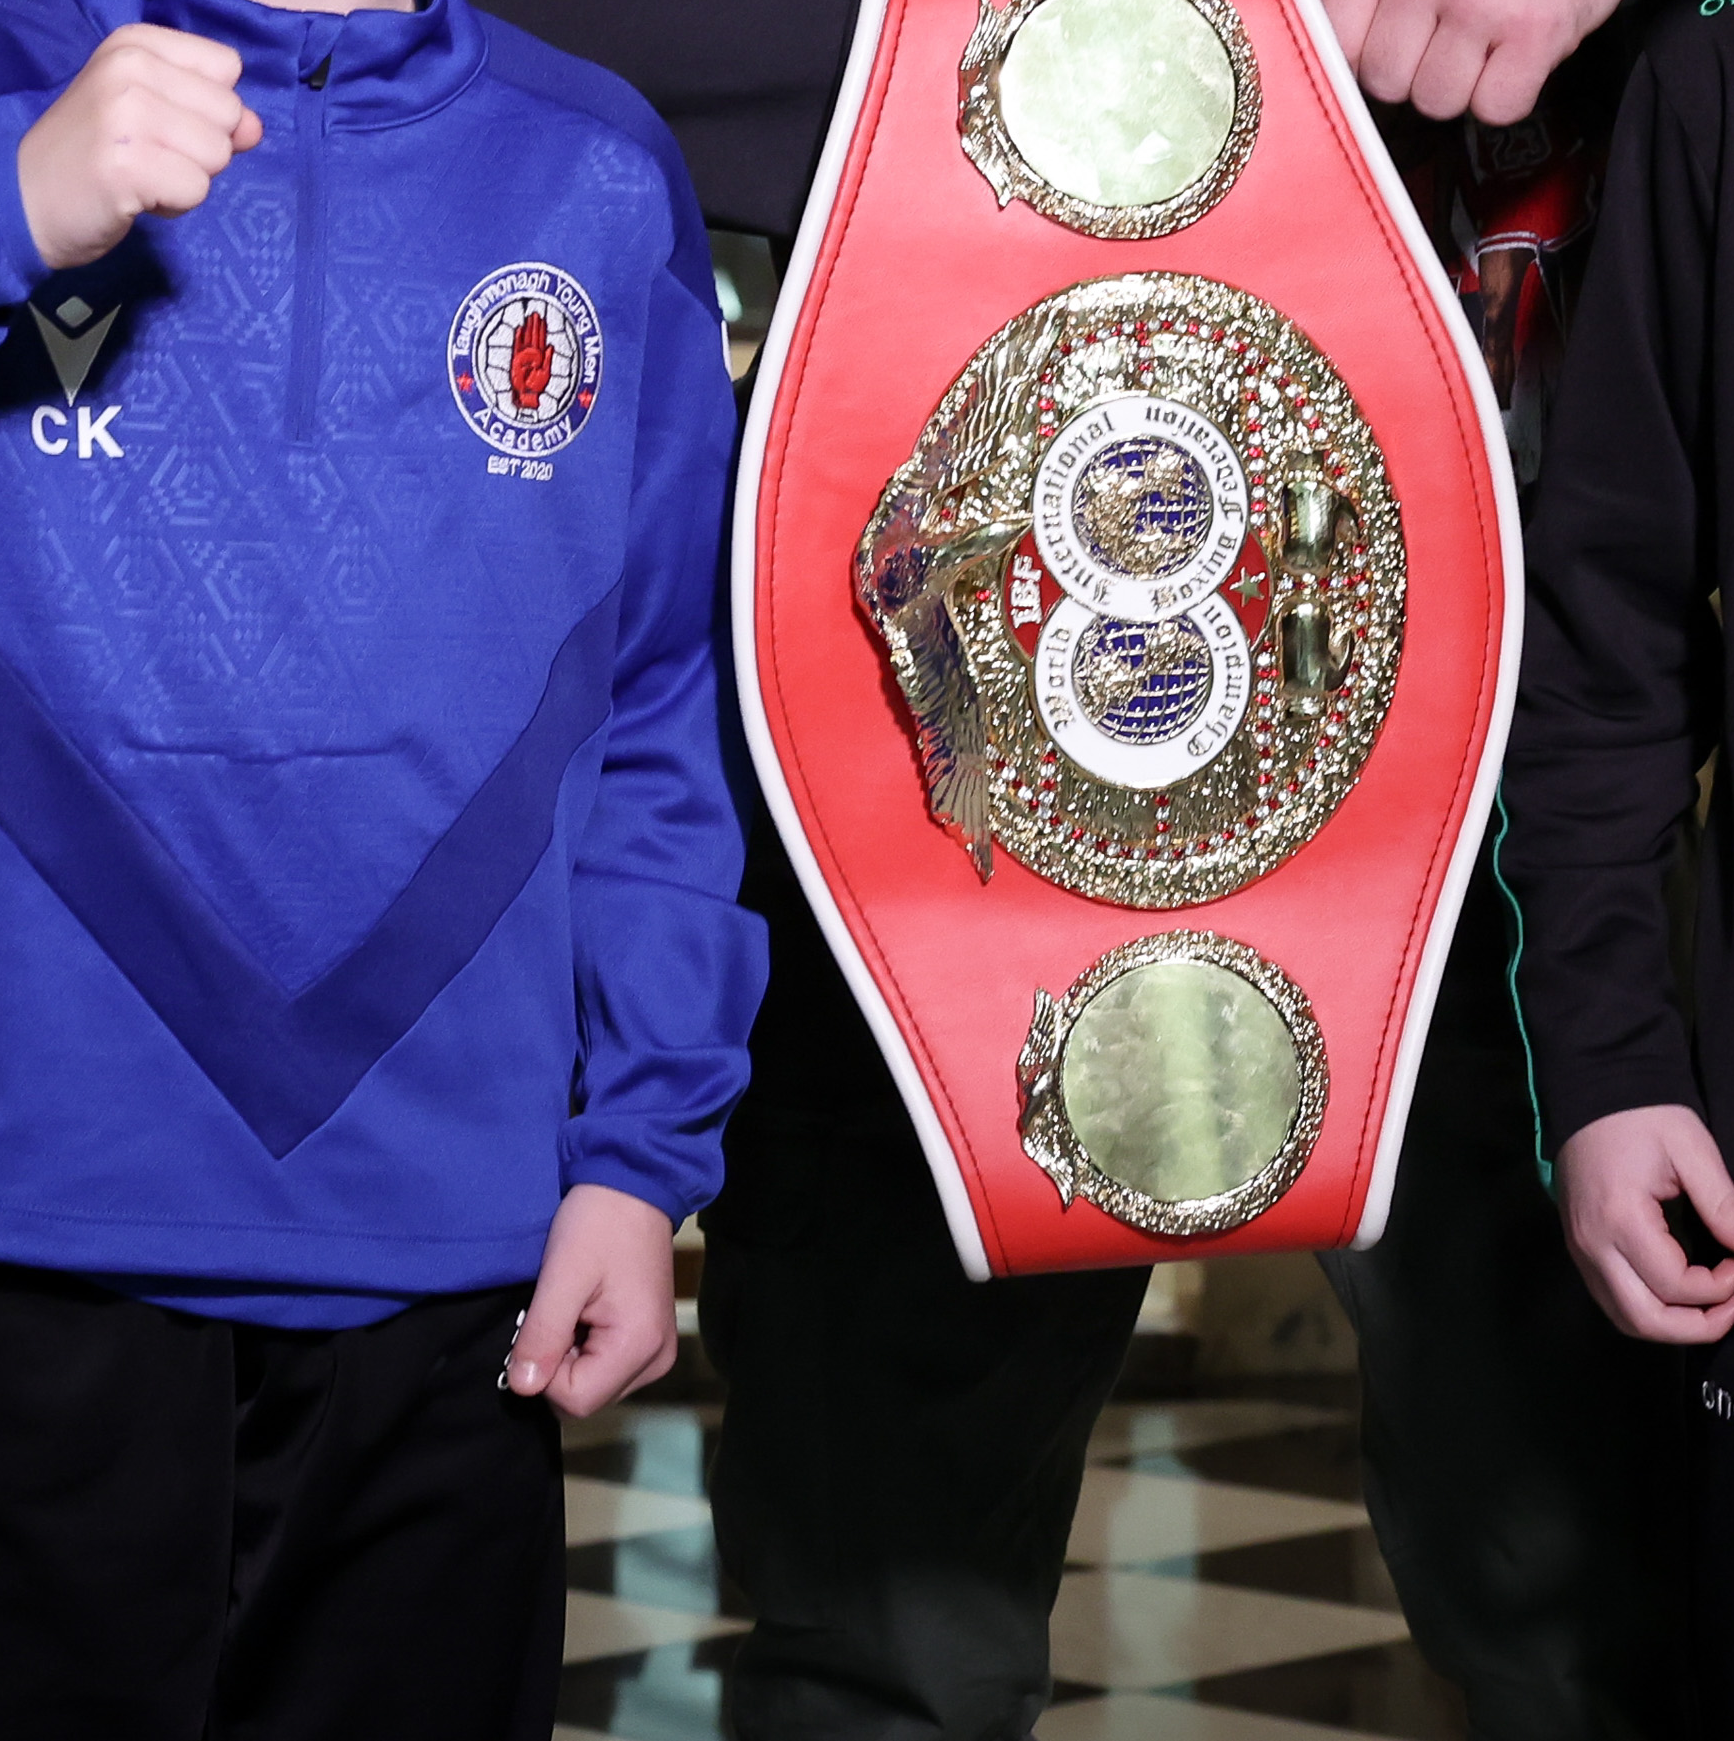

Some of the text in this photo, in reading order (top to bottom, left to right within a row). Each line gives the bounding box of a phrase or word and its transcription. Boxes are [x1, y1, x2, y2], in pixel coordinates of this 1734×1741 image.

[555, 276, 593, 336] Young
[582, 333, 602, 384] Men
[31, 404, 125, 459] CK
[473, 408, 574, 451] Academy
[487, 454, 555, 482] EST 2020
[1041, 409, 1117, 607] International
[1142, 404, 1244, 614] Boxing Federation
[1012, 553, 1043, 628] IBF
[1044, 627, 1076, 734] World
[1185, 602, 1244, 758] Champion
